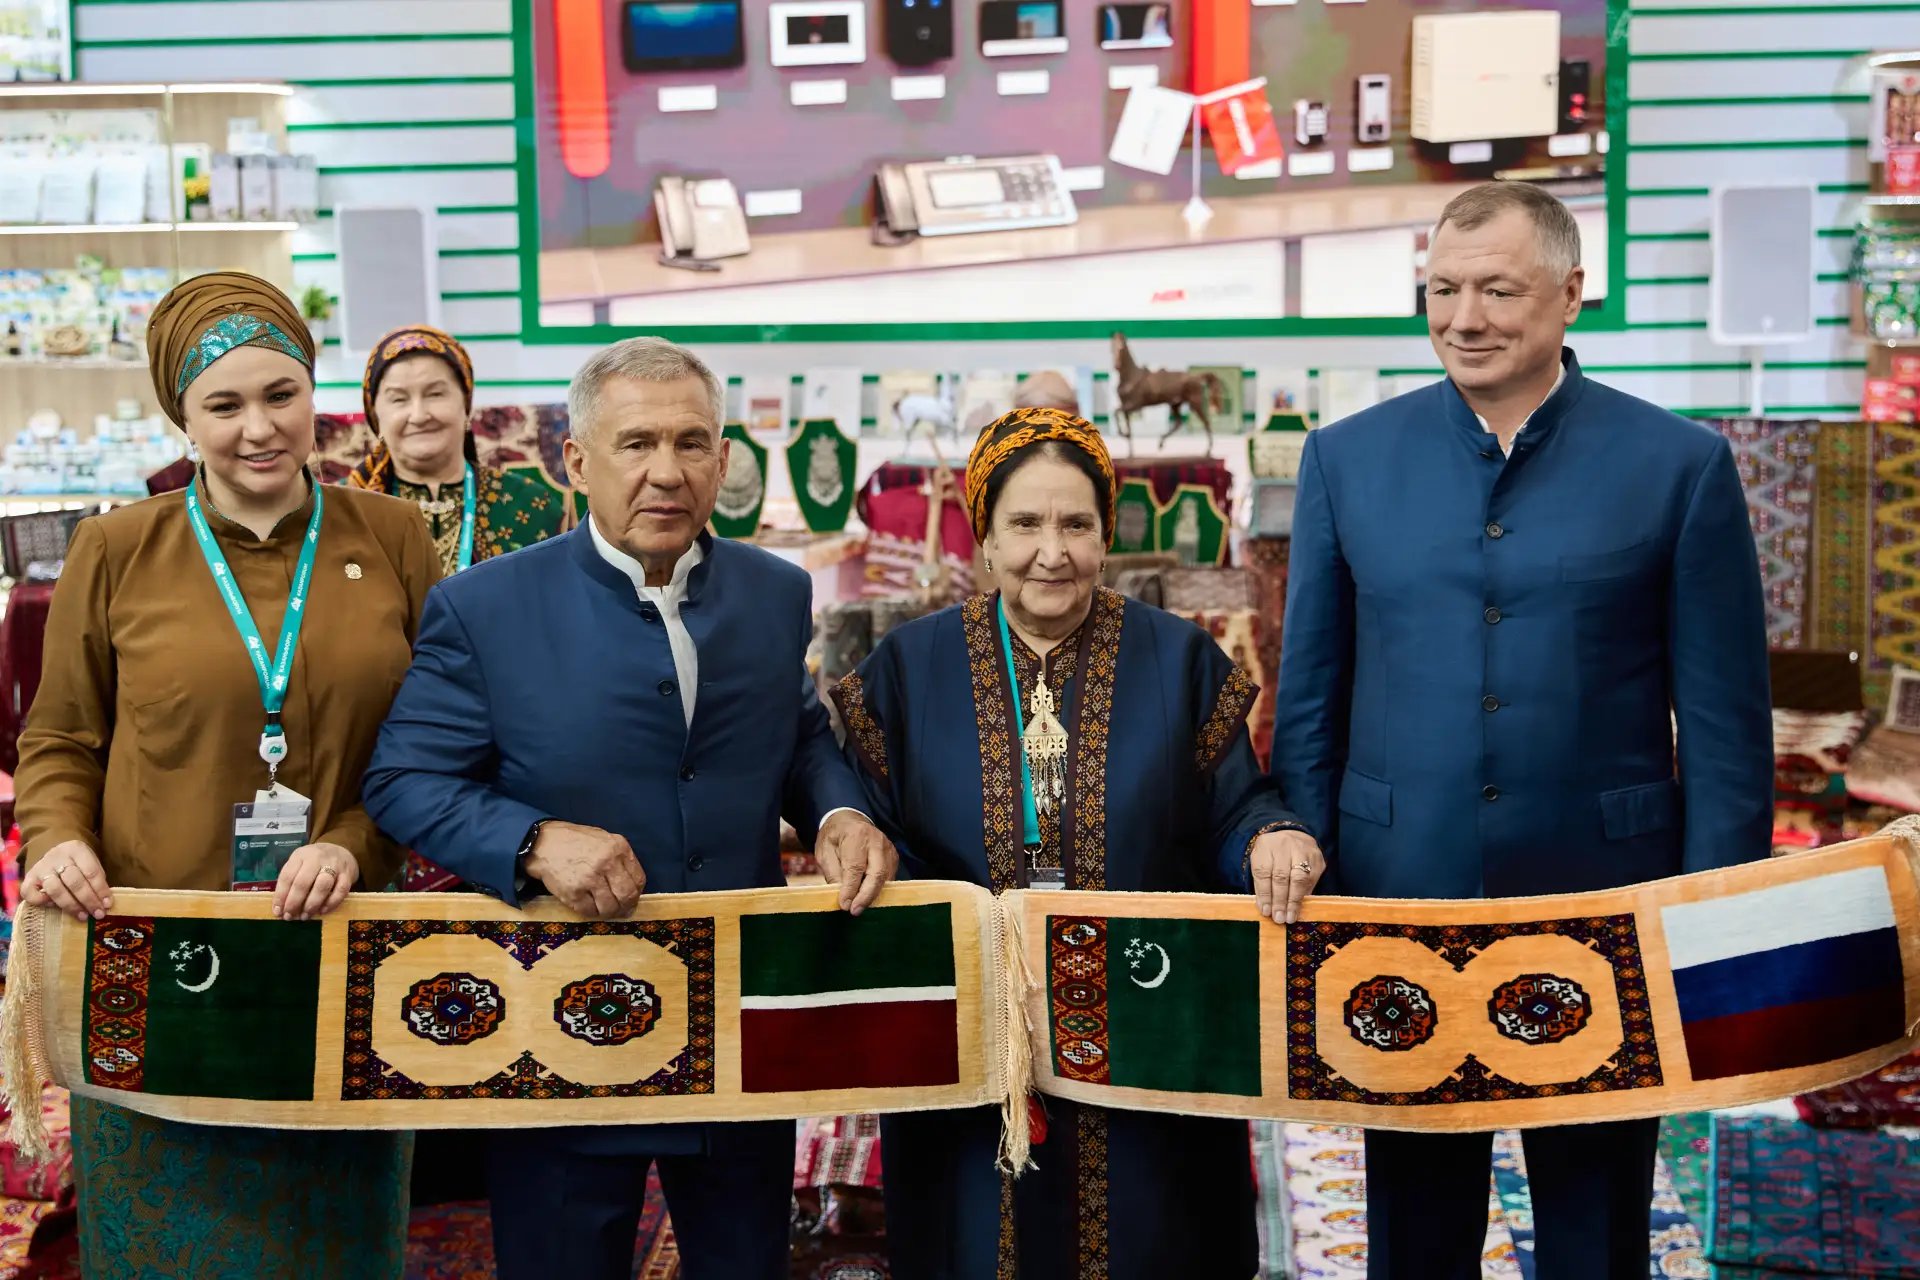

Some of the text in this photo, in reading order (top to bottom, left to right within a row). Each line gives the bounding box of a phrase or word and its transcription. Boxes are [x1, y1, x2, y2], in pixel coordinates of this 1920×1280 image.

[297, 562, 308, 597] KAZANFORUM
[255, 650, 270, 689] KAZANFORUM
[278, 631, 292, 673] КАЗАНЬФОРУМ
